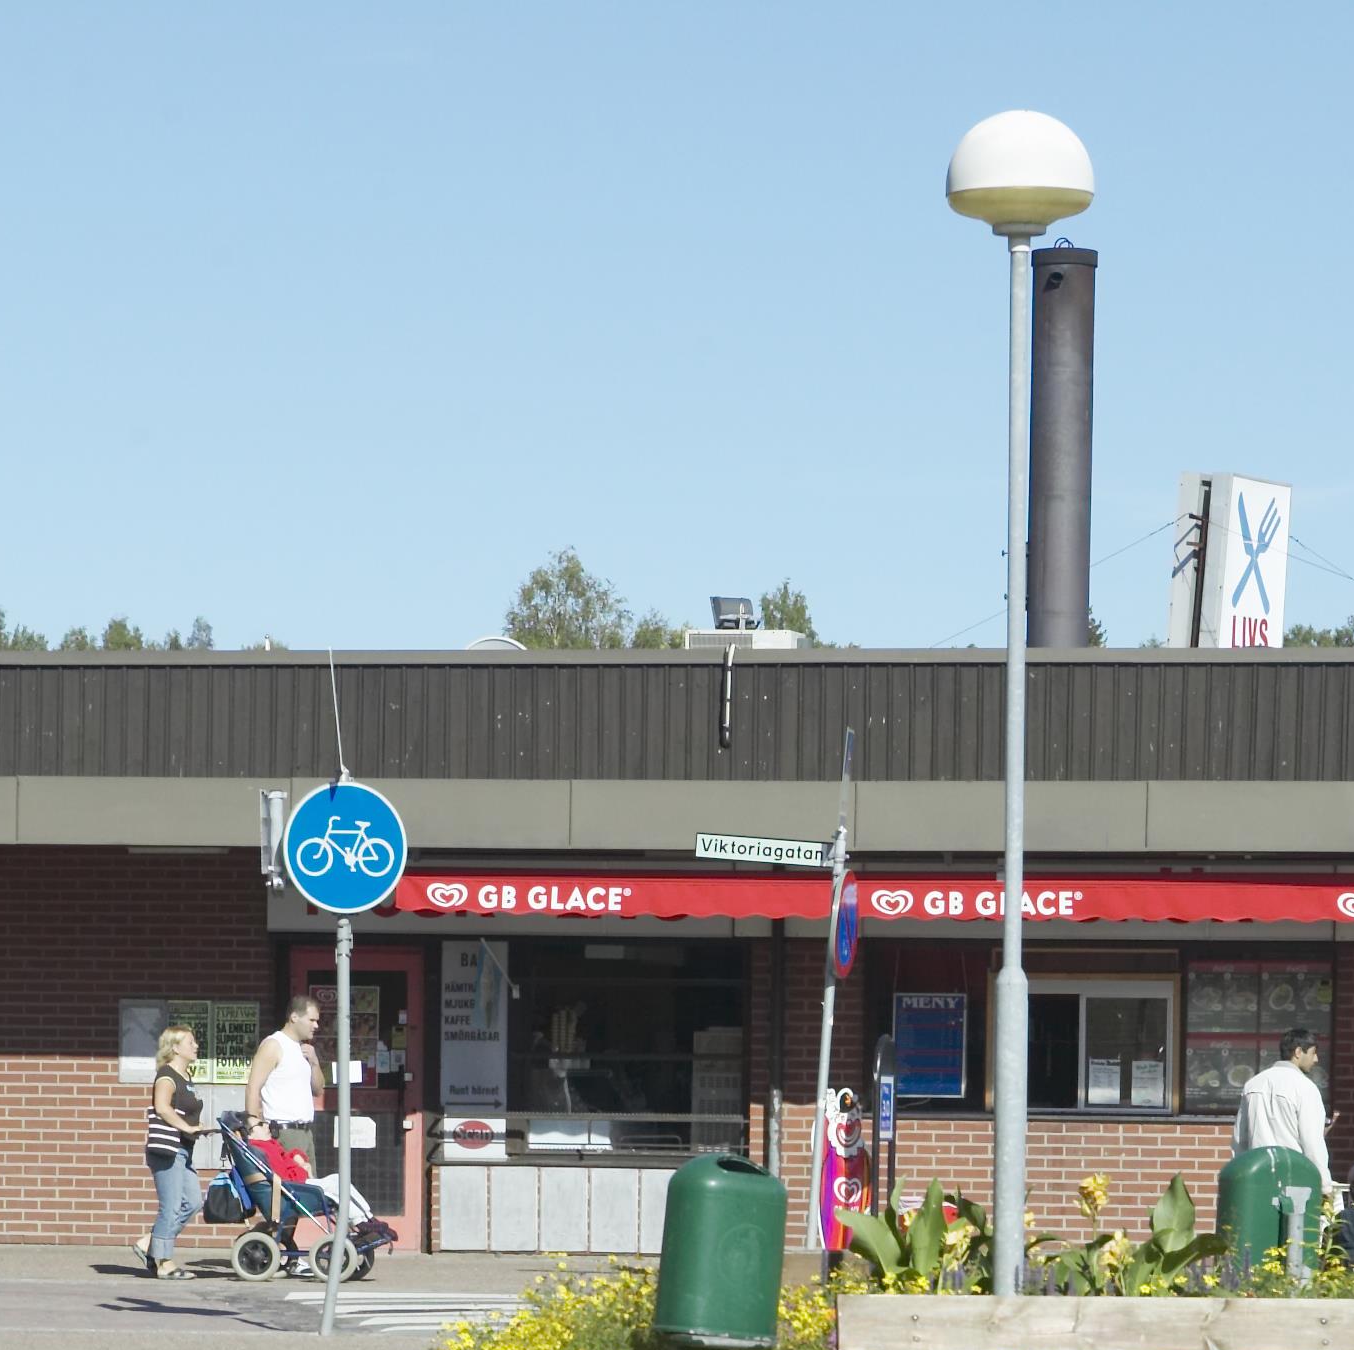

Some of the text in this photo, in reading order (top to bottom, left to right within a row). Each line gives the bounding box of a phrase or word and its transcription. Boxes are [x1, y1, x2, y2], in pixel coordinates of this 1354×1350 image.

[1231, 614, 1269, 647] LIVS
[701, 837, 824, 861] Viktoriagatan
[477, 885, 516, 909] GB
[923, 890, 964, 915] GB
[901, 997, 959, 1009] MENY
